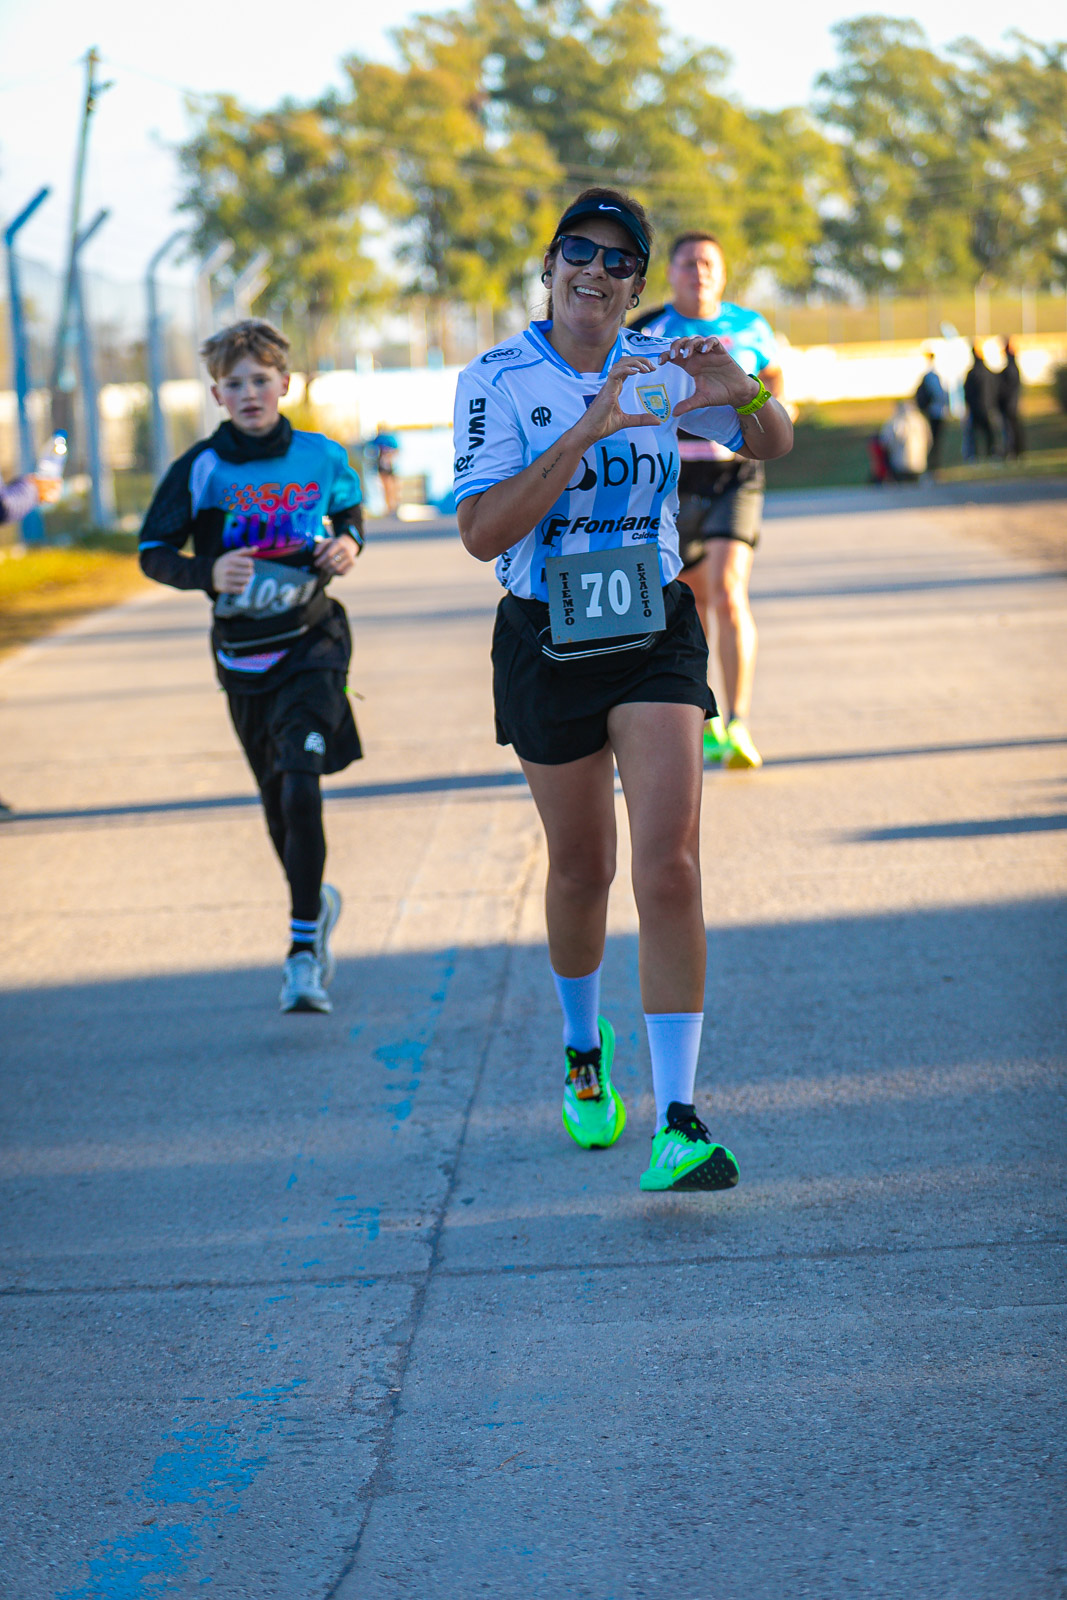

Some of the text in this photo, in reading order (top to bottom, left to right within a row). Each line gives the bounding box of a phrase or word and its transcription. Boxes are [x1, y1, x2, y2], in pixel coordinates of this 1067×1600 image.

[468, 398, 486, 451] VMG
[531, 406, 552, 427] AR
[601, 442, 673, 493] bhy
[559, 572, 575, 626] TIEMPO
[580, 569, 632, 618] 70
[636, 562, 652, 618] EXACTO
